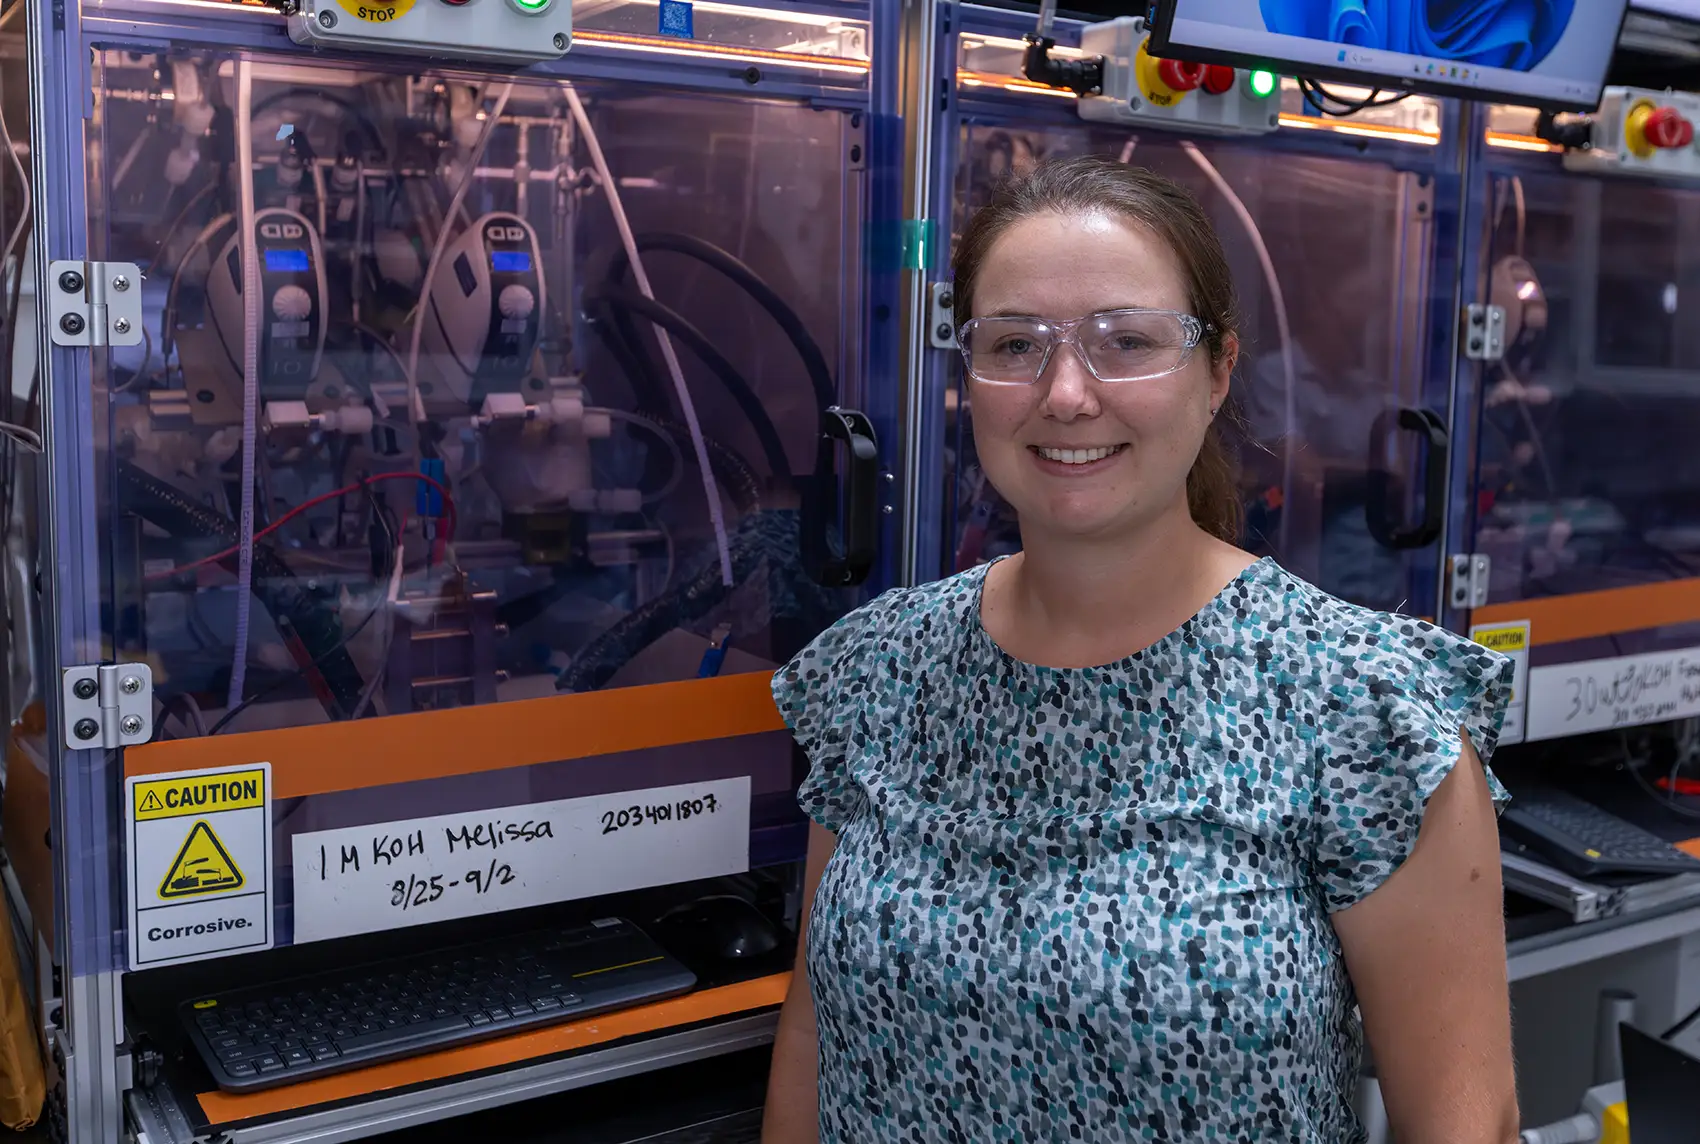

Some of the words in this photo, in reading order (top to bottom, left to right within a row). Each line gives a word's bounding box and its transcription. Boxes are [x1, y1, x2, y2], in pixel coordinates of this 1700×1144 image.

[357, 6, 396, 22] STOP
[1486, 629, 1524, 646] CAUTION
[165, 779, 257, 808] CAUTION
[340, 846, 360, 874] M
[373, 829, 425, 865] KOH
[446, 819, 553, 855] Melissa
[148, 918, 253, 942] Corrosive.
